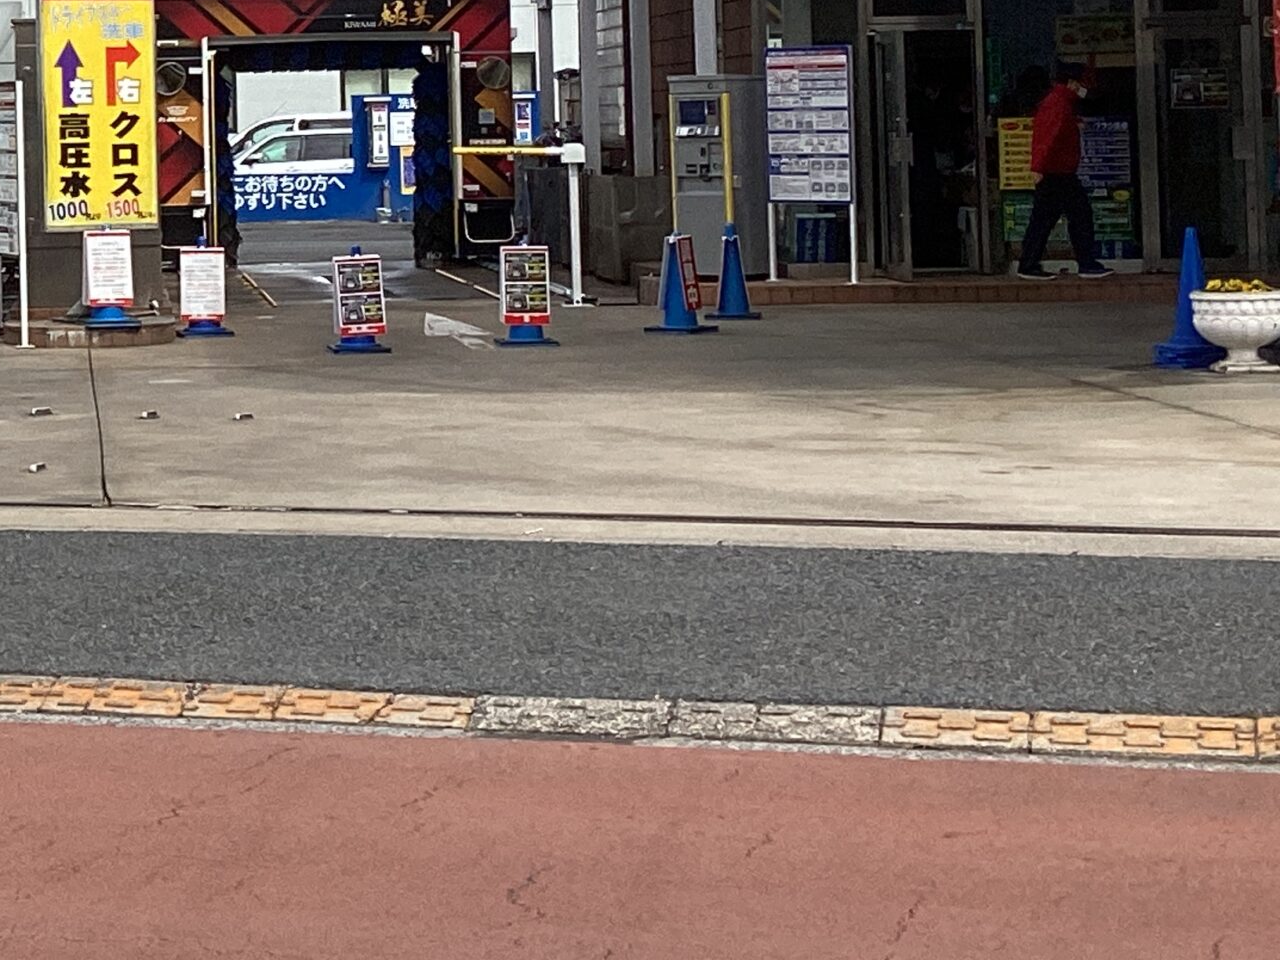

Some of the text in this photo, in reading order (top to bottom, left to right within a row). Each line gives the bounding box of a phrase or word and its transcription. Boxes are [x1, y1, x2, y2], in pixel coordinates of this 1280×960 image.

[69, 77, 94, 105] 左
[117, 77, 141, 105] 右
[58, 113, 92, 198] 高圧水
[110, 111, 142, 198] クロス
[49, 200, 88, 221] 1000
[107, 198, 140, 218] 1500
